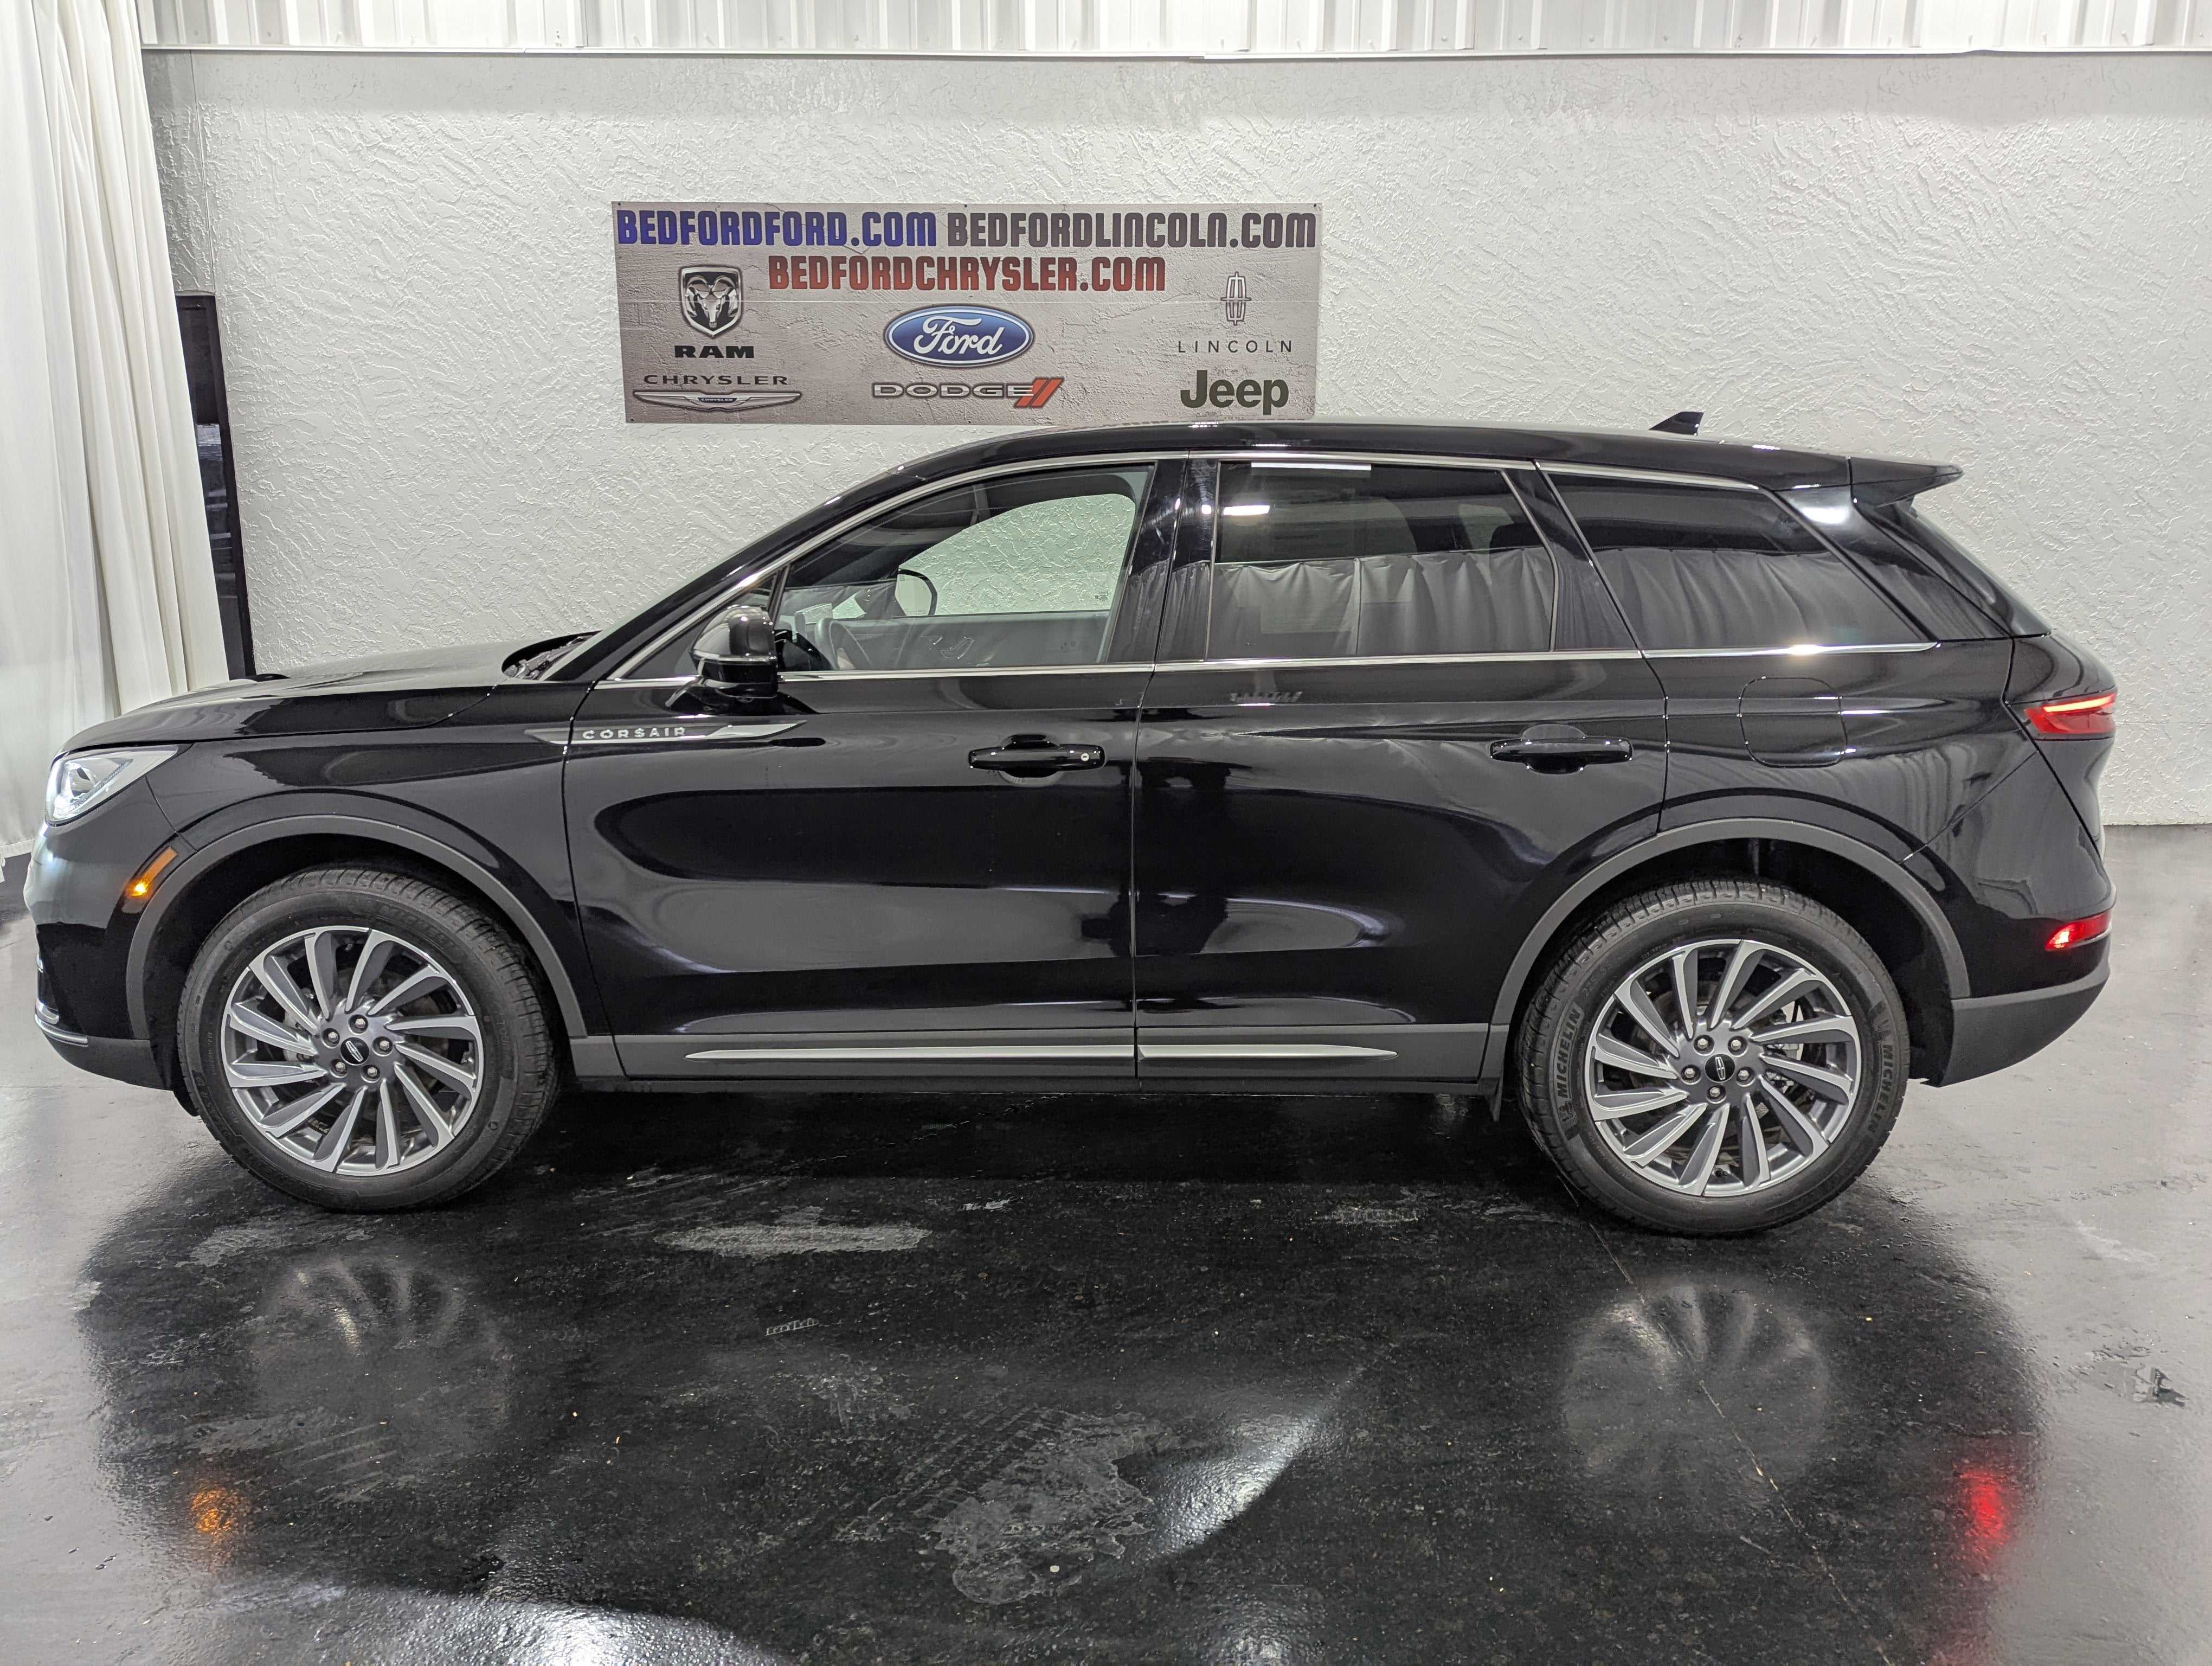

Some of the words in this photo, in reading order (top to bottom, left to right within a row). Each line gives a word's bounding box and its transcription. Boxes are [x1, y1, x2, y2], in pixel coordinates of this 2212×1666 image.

[616, 210, 936, 247] BEDFORDFORD.COM
[948, 212, 1316, 248] BEDFORDLINCOLN.COM
[768, 255, 1166, 291] BEDFORDCHRYSLER.COM
[674, 345, 755, 359] RAM
[913, 316, 1005, 355] Ford
[1179, 340, 1293, 354] LINCOLN
[644, 375, 788, 385] CHRYSLER
[873, 385, 1034, 398] DODGE
[1180, 370, 1289, 415] Jeep
[582, 727, 686, 740] CORSAIR
[1557, 1008, 1580, 1098] MICHELIN
[1868, 1044, 1893, 1133] MICHELIN
